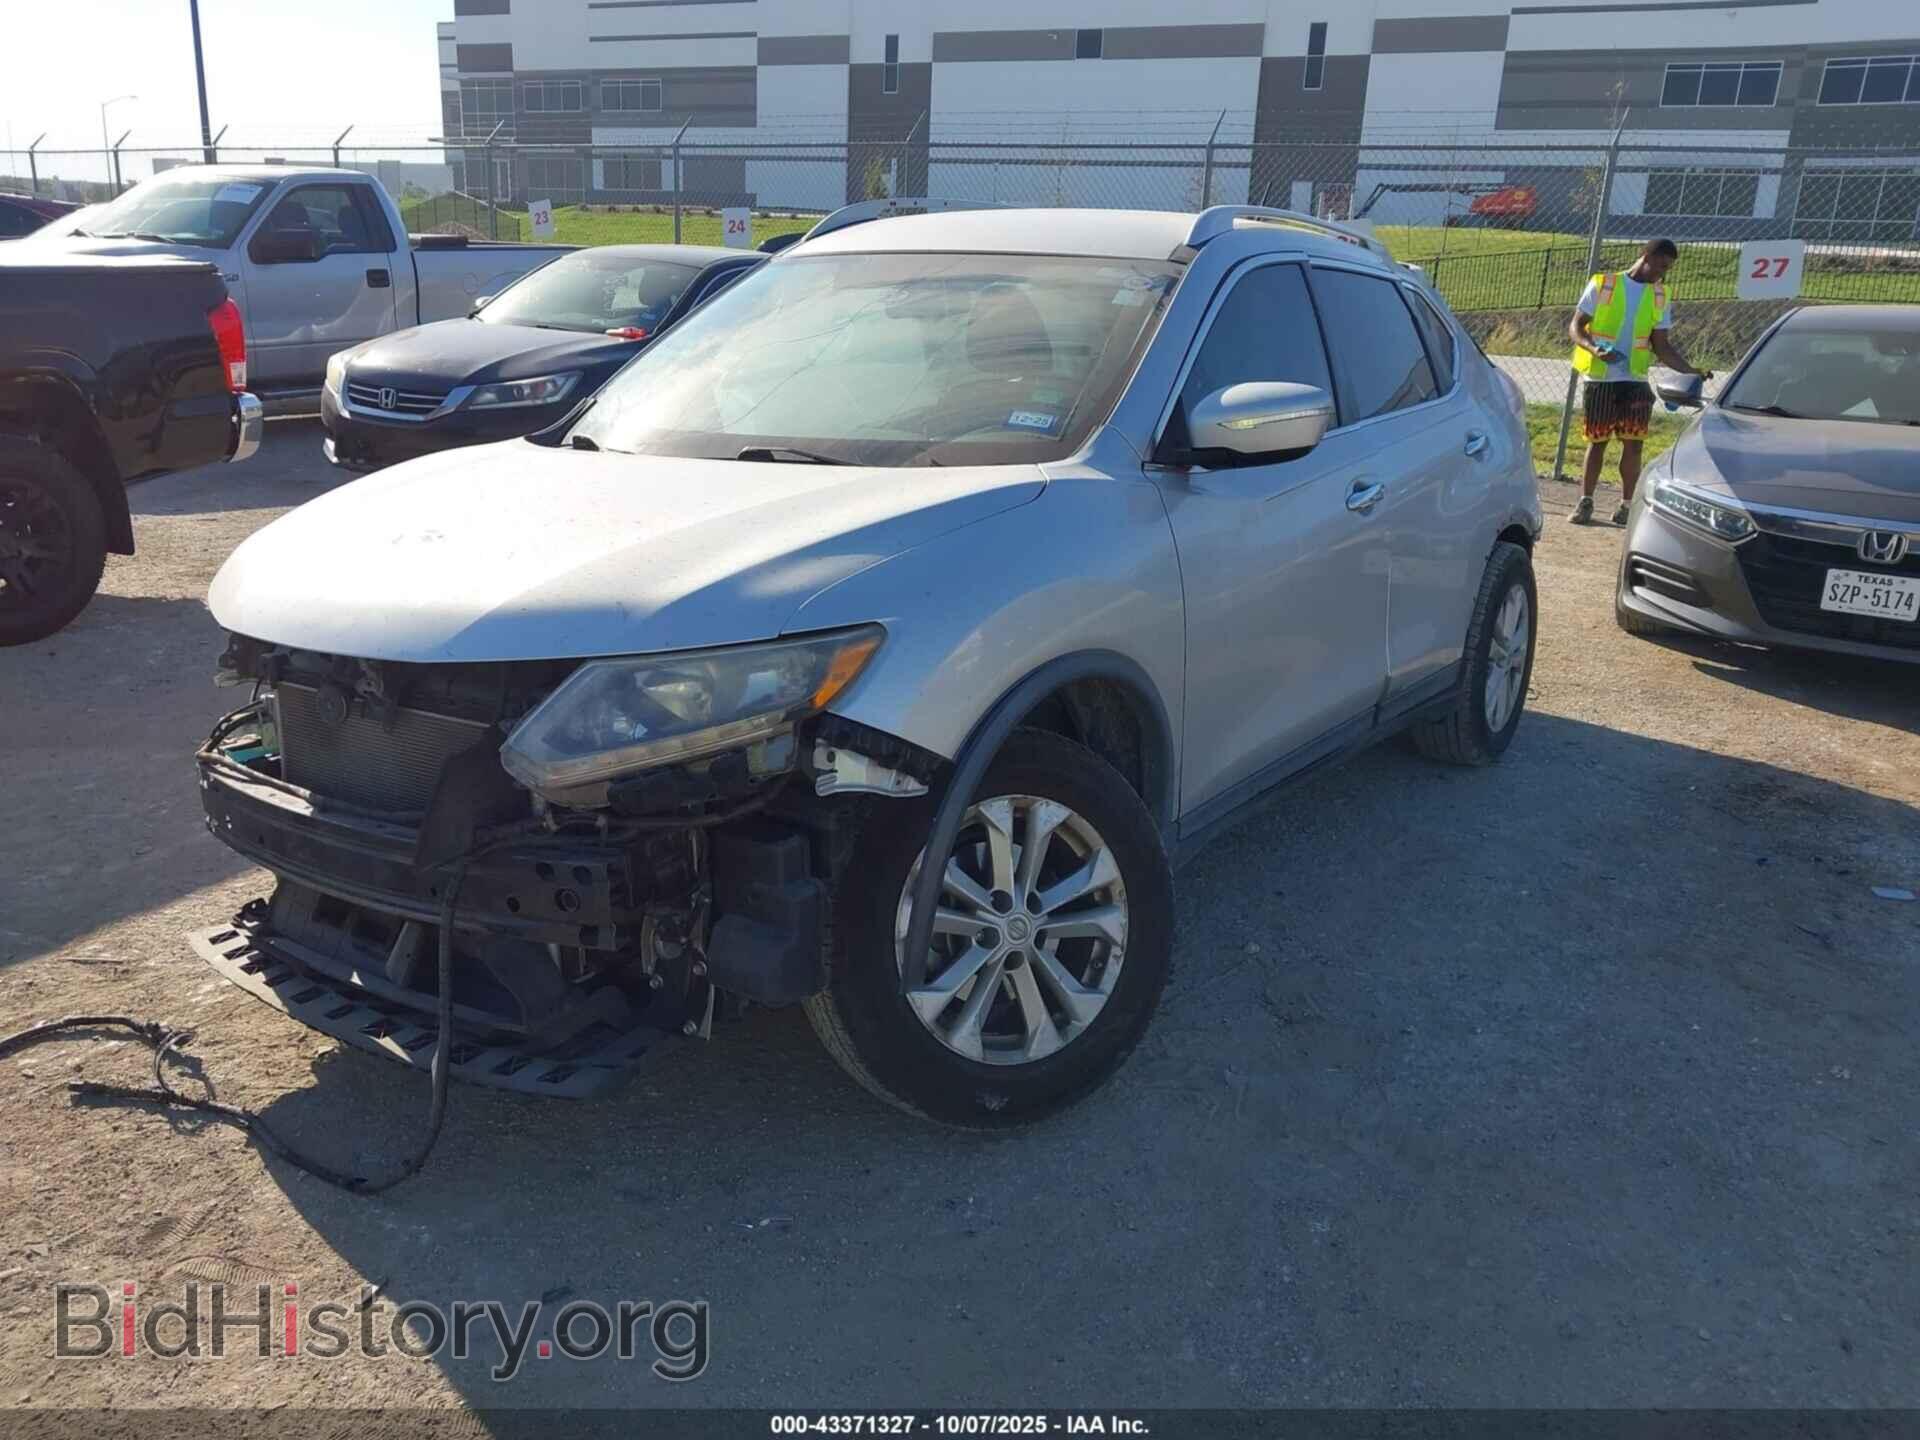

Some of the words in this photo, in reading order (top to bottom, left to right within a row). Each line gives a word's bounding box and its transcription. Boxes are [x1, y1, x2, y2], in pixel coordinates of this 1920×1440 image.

[535, 210, 549, 225] 23
[728, 219, 746, 233] 24
[1751, 257, 1790, 278] 27
[1857, 574, 1894, 586] TEXAS
